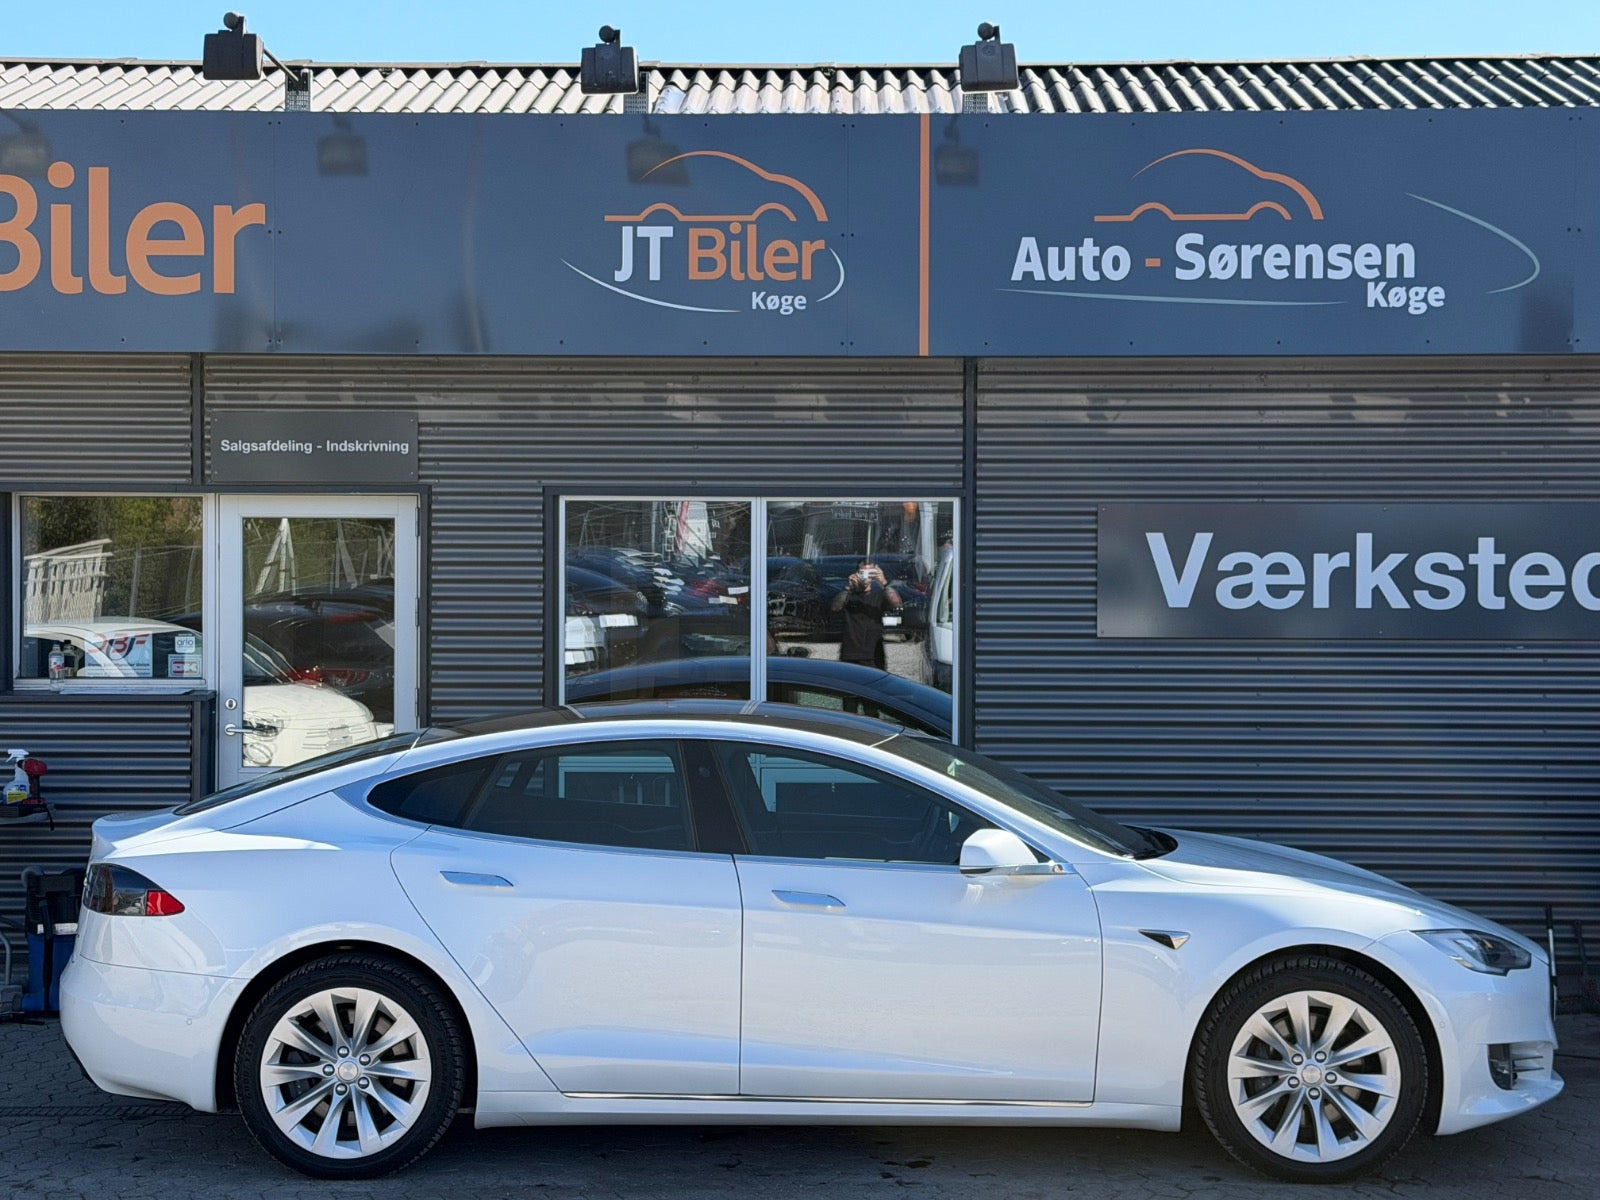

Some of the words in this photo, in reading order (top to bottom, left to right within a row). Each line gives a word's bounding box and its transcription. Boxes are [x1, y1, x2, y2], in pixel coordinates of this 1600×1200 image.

[614, 225, 674, 282] JT
[687, 222, 826, 282] Biler
[1010, 236, 1131, 282] Auto
[1175, 232, 1415, 281] Sørensen
[751, 291, 807, 315] Køge
[1367, 281, 1446, 315] Køge
[220, 439, 313, 454] Salgsafdeling
[326, 439, 409, 454] Indskrivning
